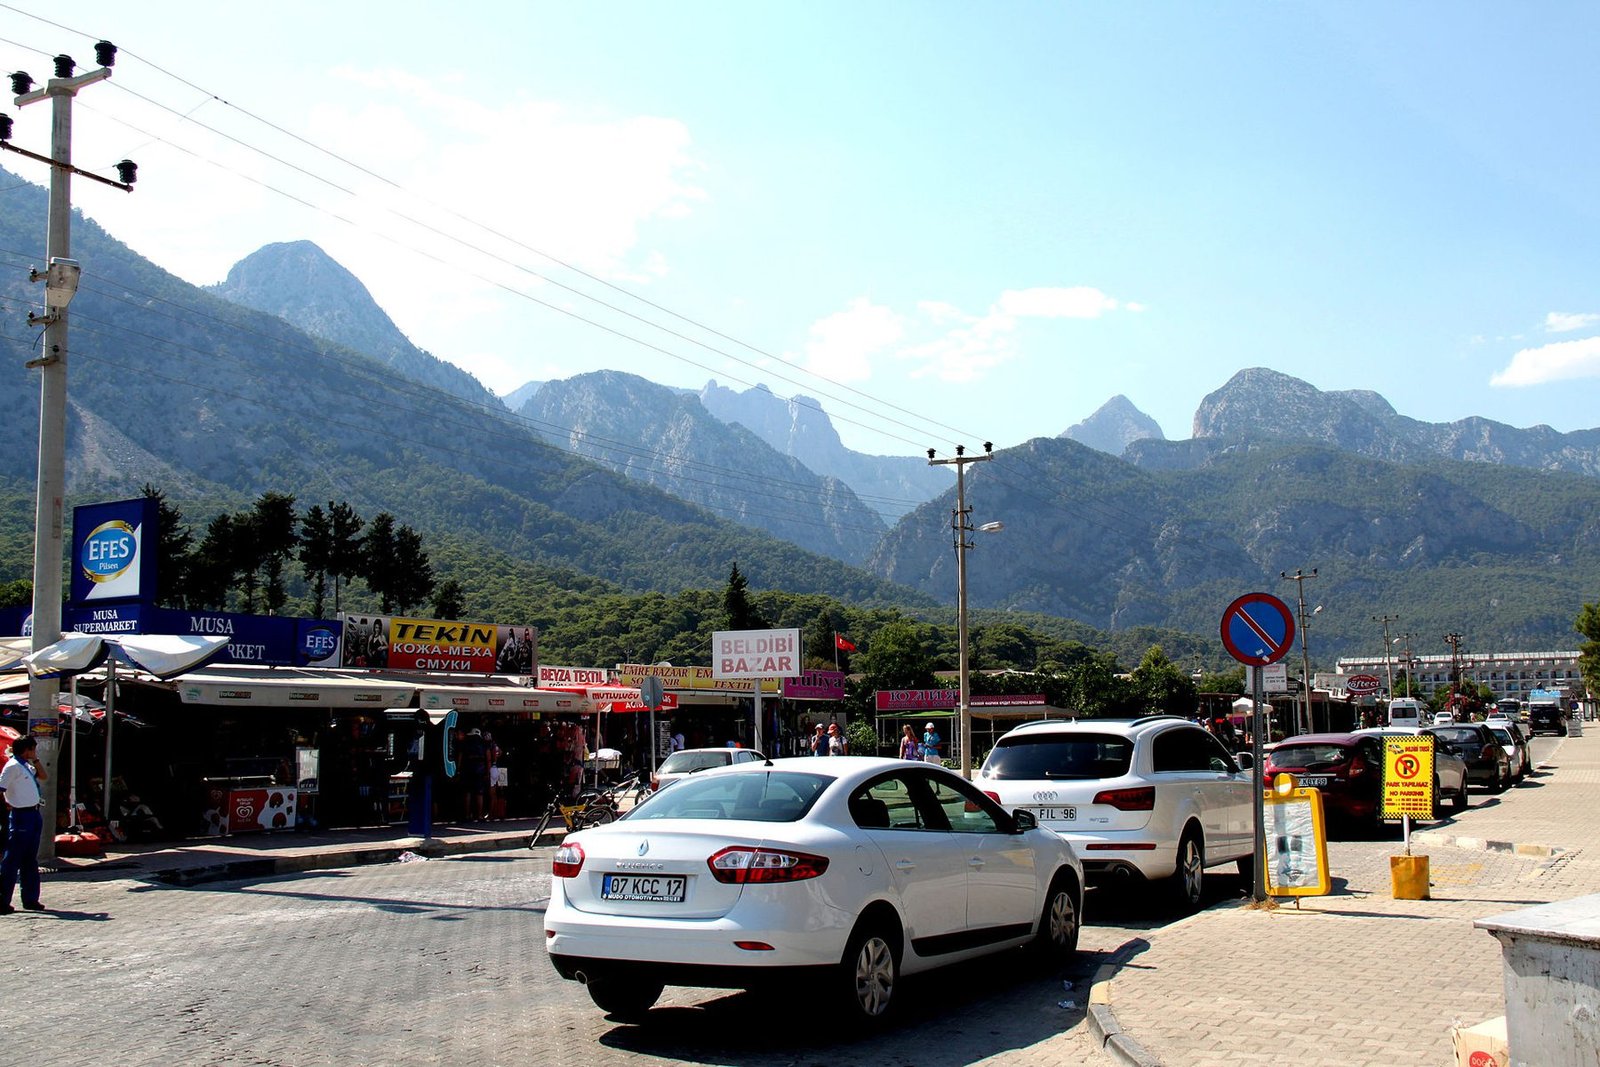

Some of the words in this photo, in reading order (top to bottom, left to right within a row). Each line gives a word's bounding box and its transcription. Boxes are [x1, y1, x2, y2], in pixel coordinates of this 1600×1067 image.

[88, 538, 129, 560] EFES
[93, 610, 118, 620] MUSA
[74, 620, 137, 632] SUPERMARKET
[190, 617, 234, 634] MUSA
[396, 624, 493, 643] TEKİN
[306, 635, 335, 649] EFES
[721, 634, 793, 654] BELDİBİ
[393, 643, 493, 657] КОЖА-МЕХА
[415, 659, 471, 670] СМУКИ
[721, 656, 792, 673] BAZAR
[541, 668, 571, 681] BEYZA
[574, 670, 604, 683] TEXTIL
[623, 666, 650, 680] EMRE
[652, 669, 688, 682] BAZAAR
[1040, 809, 1055, 819] FIL
[611, 878, 628, 893] 07
[632, 879, 659, 894] KCC
[667, 880, 682, 895] 17
